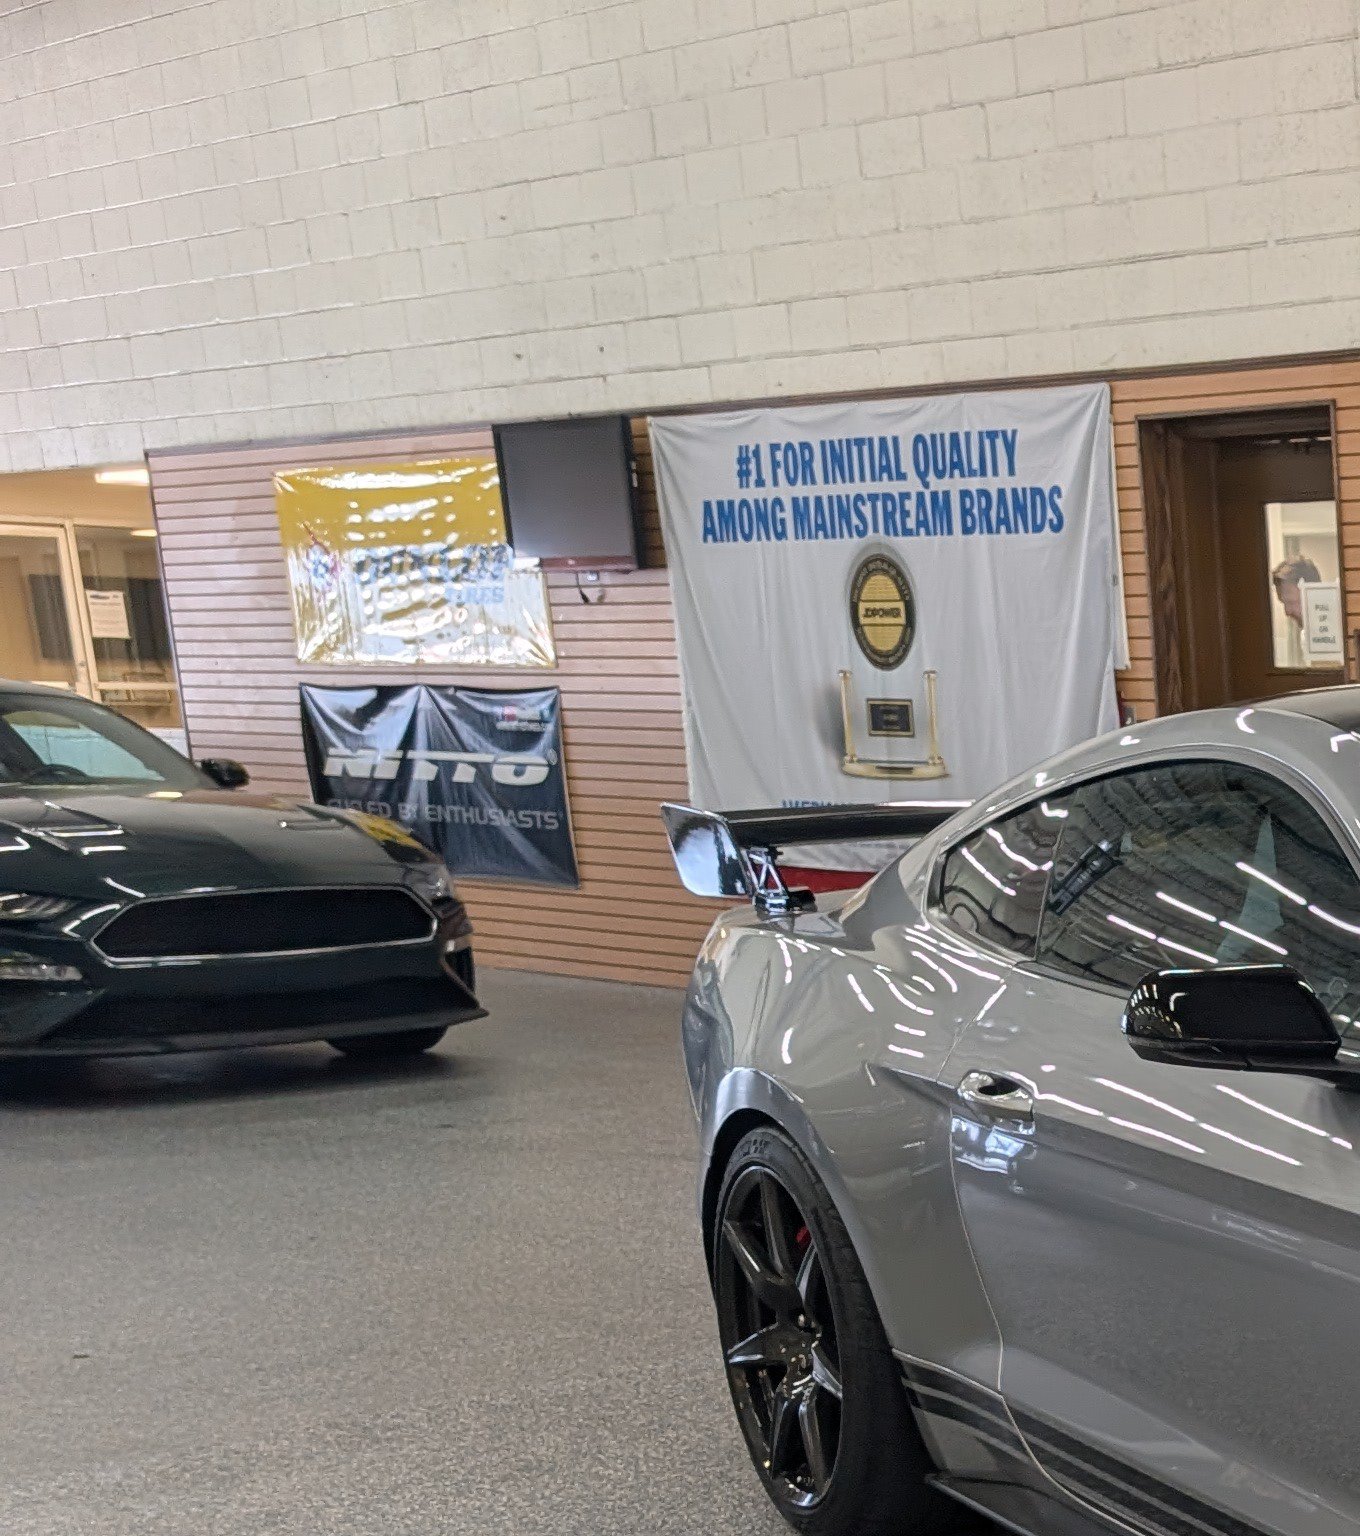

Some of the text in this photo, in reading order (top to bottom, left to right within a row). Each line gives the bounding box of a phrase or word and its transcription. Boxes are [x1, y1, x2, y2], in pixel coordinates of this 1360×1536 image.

[736, 429, 1019, 489] #1 FOR INITIAL QUALITY
[702, 485, 1065, 543] AMONG MAINSTREAM BRANDS
